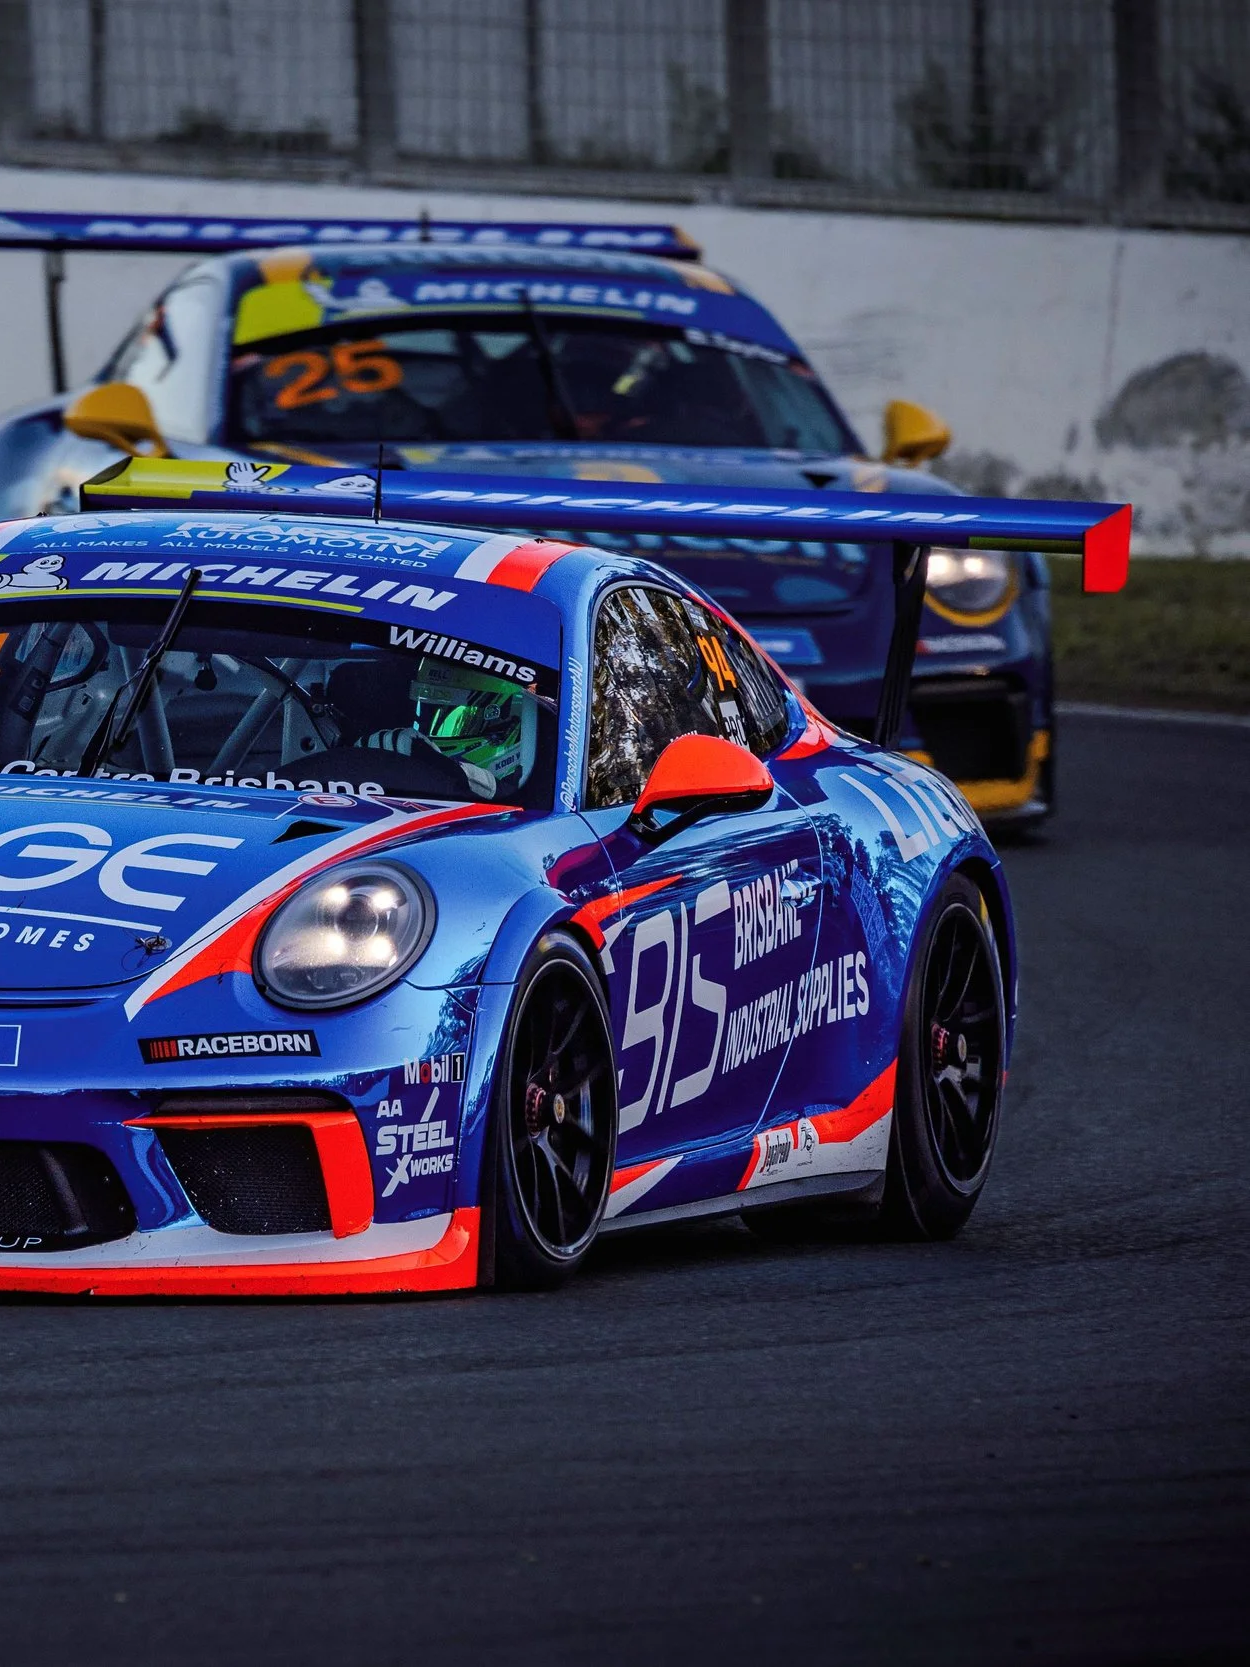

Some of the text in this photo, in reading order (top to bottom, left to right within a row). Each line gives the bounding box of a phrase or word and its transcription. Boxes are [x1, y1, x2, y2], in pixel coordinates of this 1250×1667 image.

[416, 281, 698, 315] MICHELIN
[263, 340, 403, 409] 25
[406, 490, 980, 524] MICHELIN
[34, 540, 428, 568] ALL MAKES ALL MODELS ALL SORTED
[162, 531, 441, 559] AUTOMOTIVE
[80, 562, 458, 611] MICHELIN
[390, 626, 536, 682] Williams
[697, 636, 737, 691] 94
[722, 951, 869, 1074] INDUSTRIAL SUPPLIES
[178, 1034, 311, 1056] RACEBORN
[403, 1055, 449, 1085] Mobil
[376, 1099, 403, 1118] AA
[375, 1120, 454, 1156] STEEL
